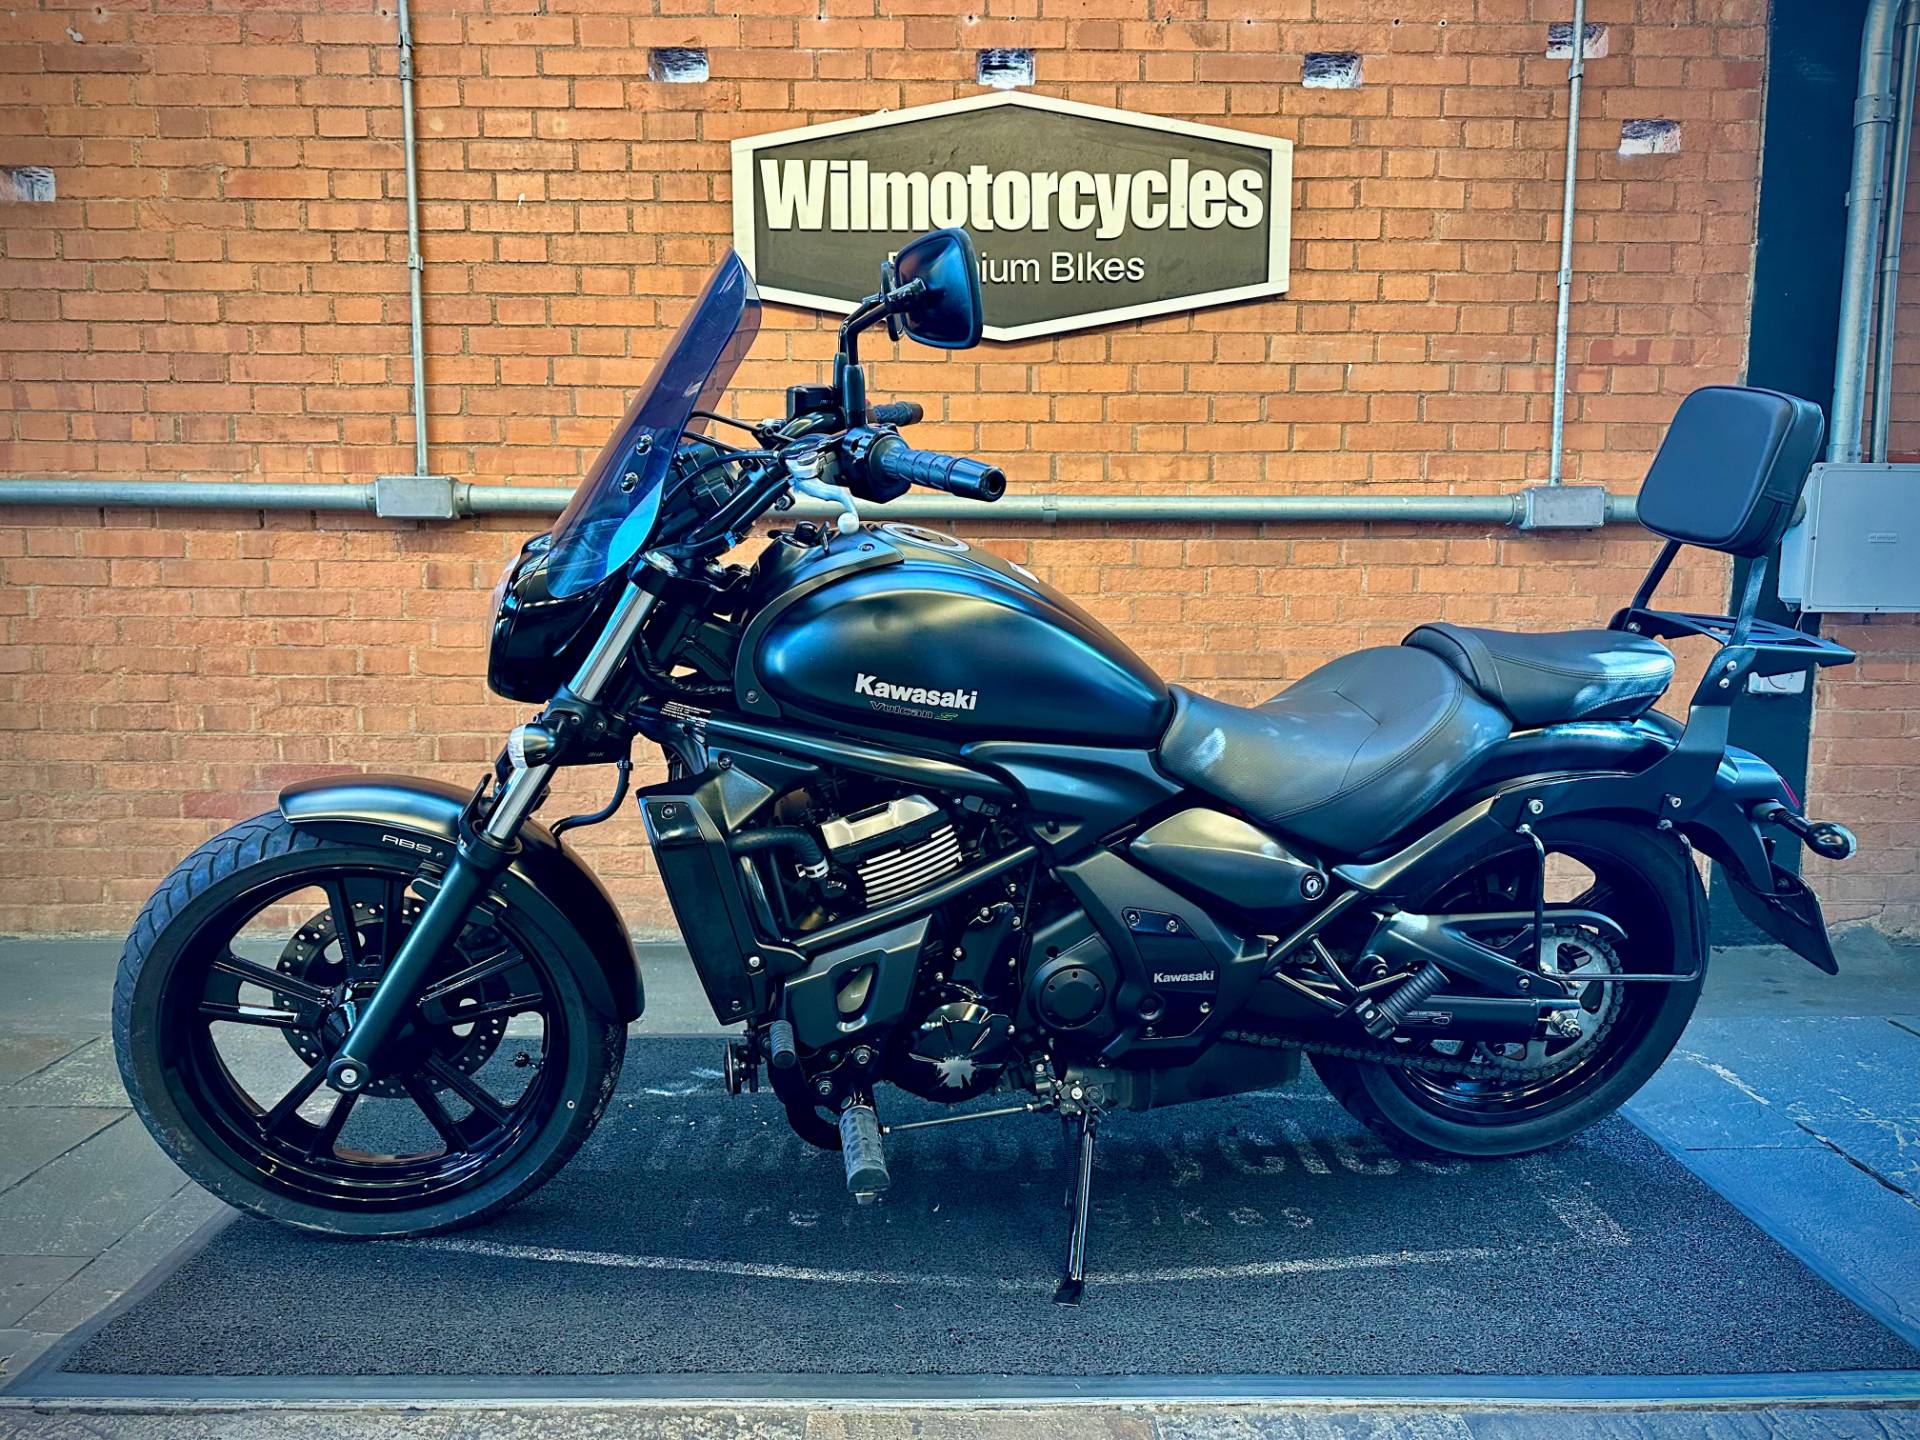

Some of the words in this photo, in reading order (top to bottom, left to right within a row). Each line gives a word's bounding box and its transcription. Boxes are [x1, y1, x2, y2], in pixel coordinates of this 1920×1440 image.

[760, 159, 1264, 239] Wilmotorcycles
[854, 673, 977, 710] Kawasaki
[382, 834, 432, 854] ABS
[1153, 970, 1215, 983] Kawasaki
